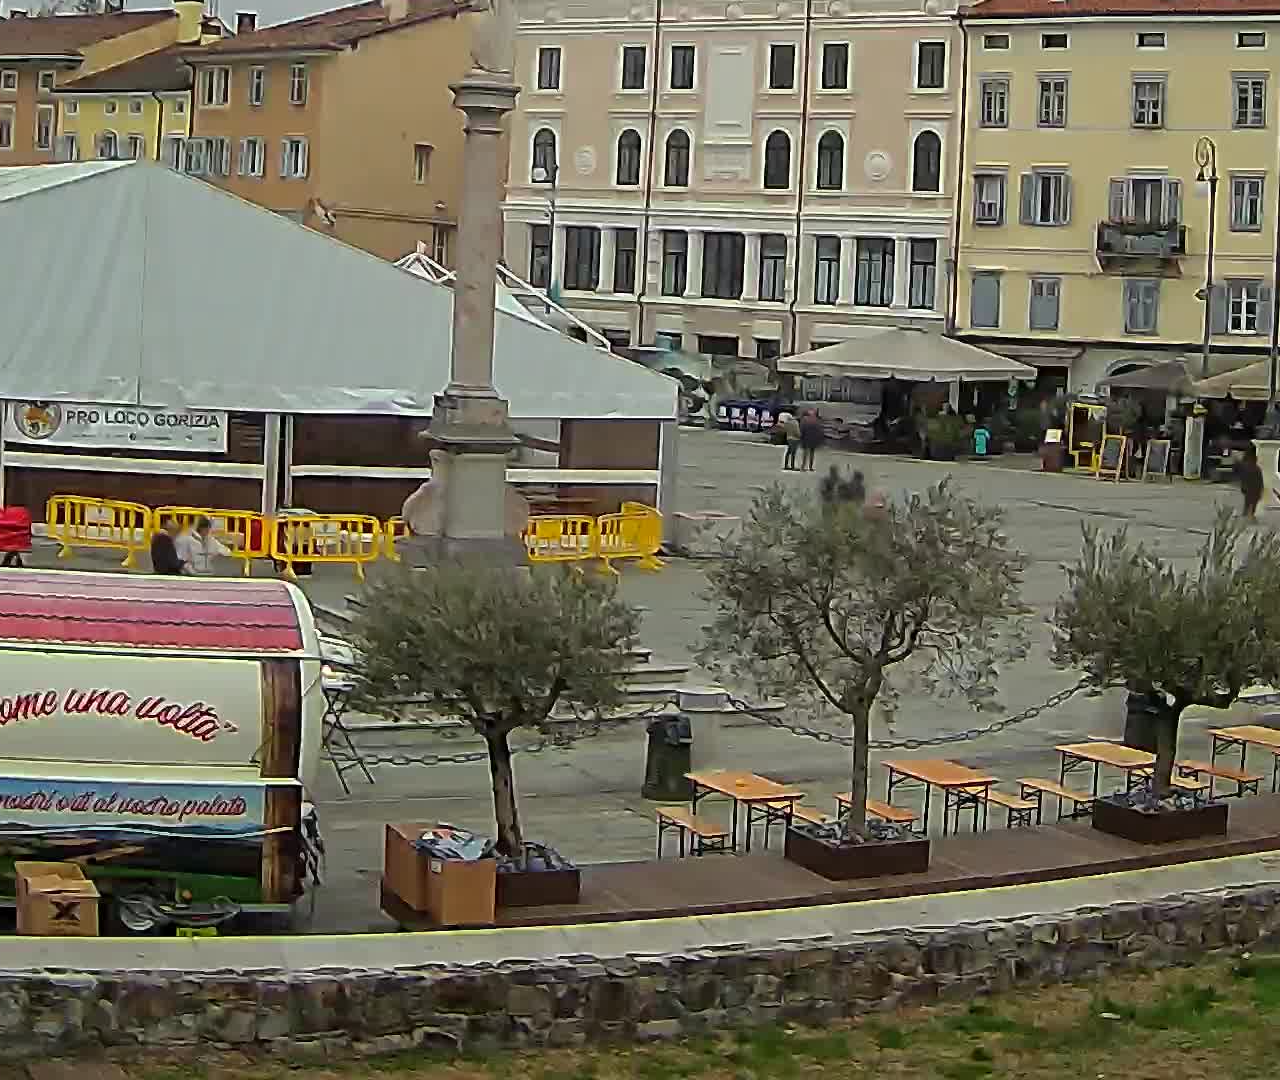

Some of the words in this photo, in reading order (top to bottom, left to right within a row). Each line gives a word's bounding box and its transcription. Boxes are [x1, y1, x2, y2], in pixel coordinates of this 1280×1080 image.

[66, 409, 100, 425] PRO
[104, 410, 150, 426] LOCO
[153, 412, 220, 428] GORIZIA
[63, 688, 130, 716] una
[92, 791, 118, 813] al
[117, 796, 180, 816] vostro
